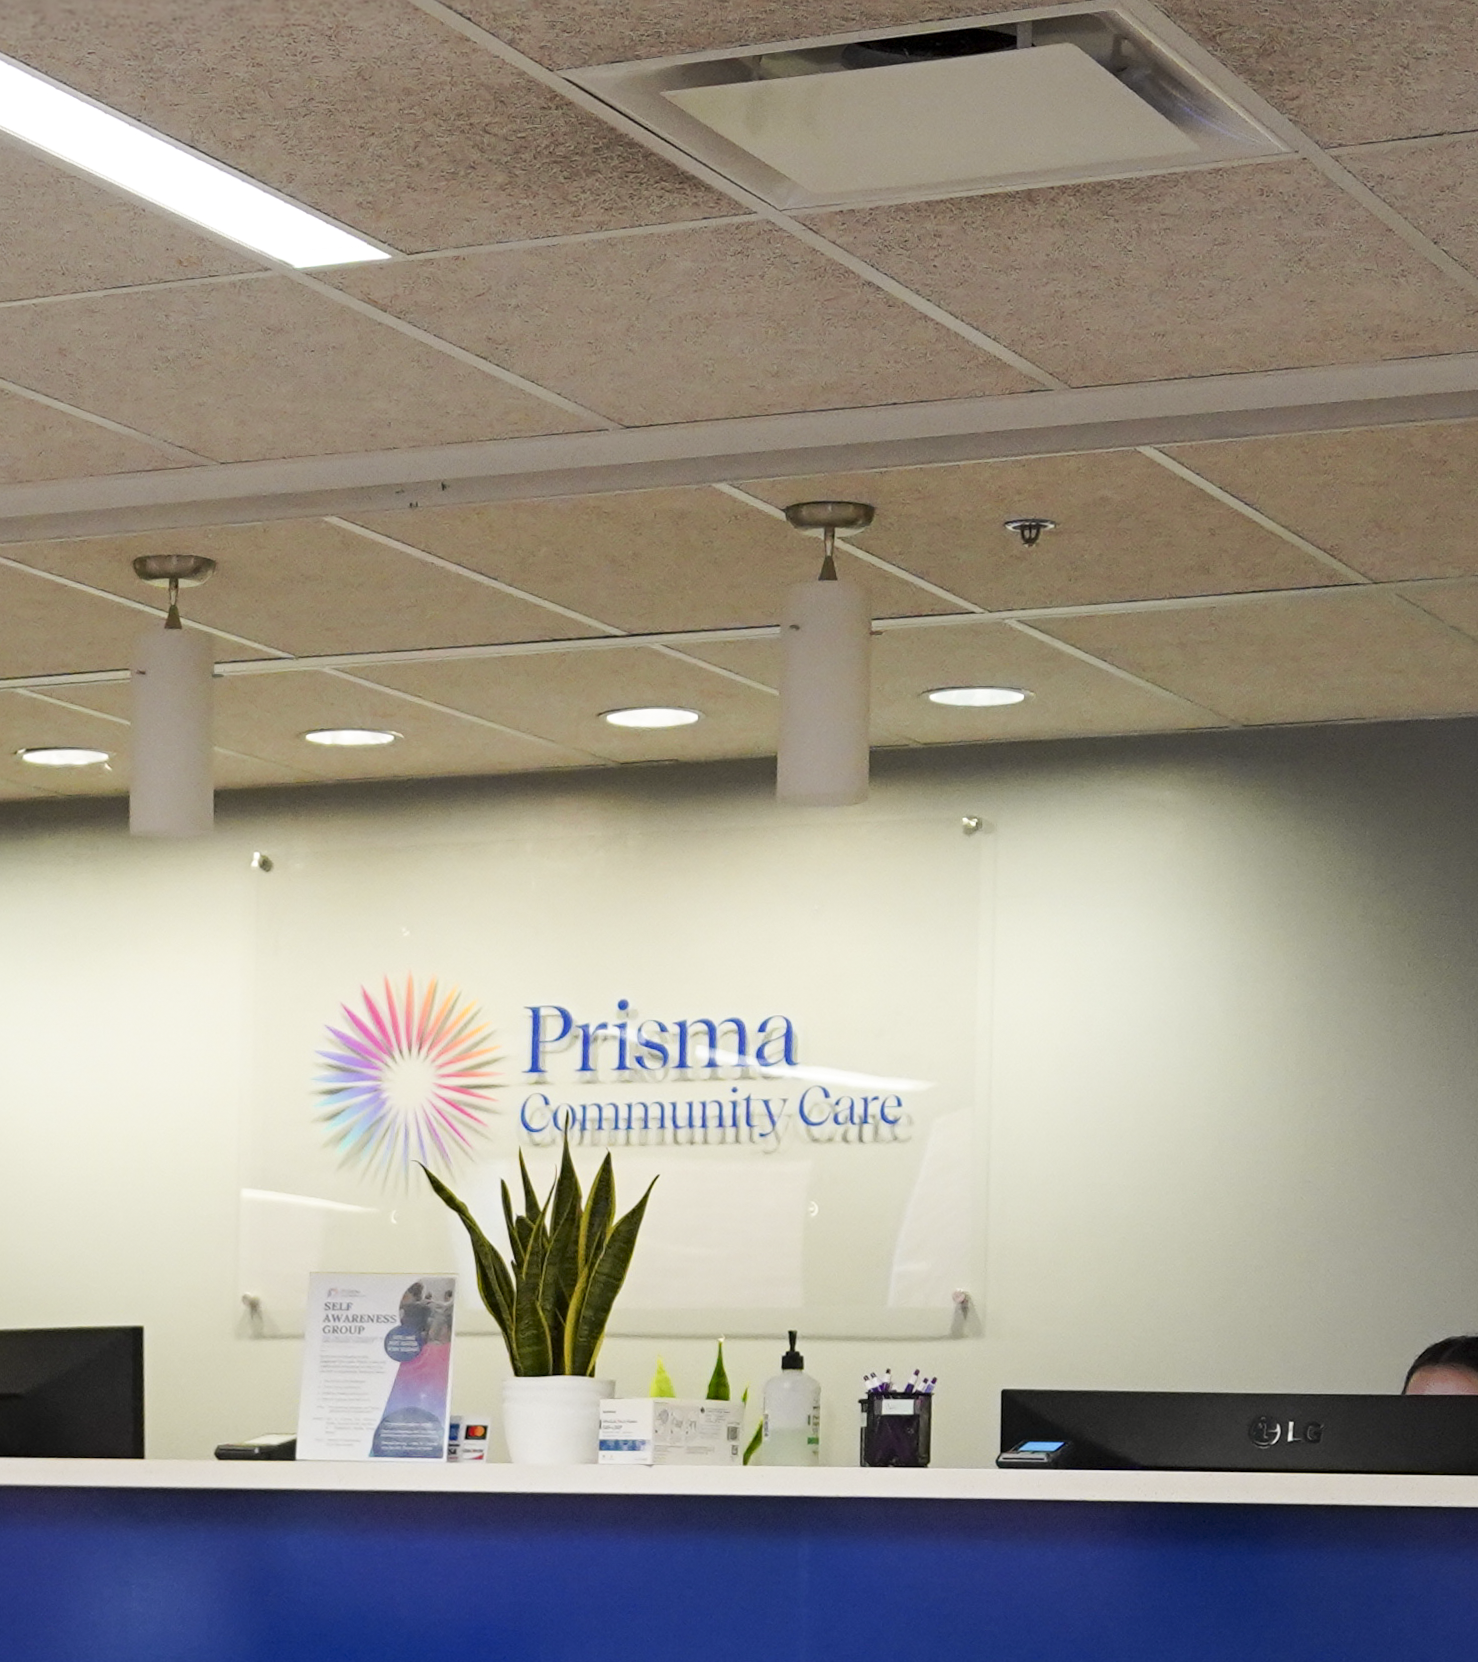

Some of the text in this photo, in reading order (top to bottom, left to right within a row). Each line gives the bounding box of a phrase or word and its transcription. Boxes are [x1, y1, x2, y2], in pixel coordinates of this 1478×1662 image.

[522, 998, 799, 1074] Prisma
[519, 1085, 904, 1138] Community Care
[323, 1301, 354, 1312] SELF
[322, 1314, 398, 1324] AWARENESS
[322, 1325, 366, 1335] GROUP
[1286, 1420, 1326, 1444] LG
